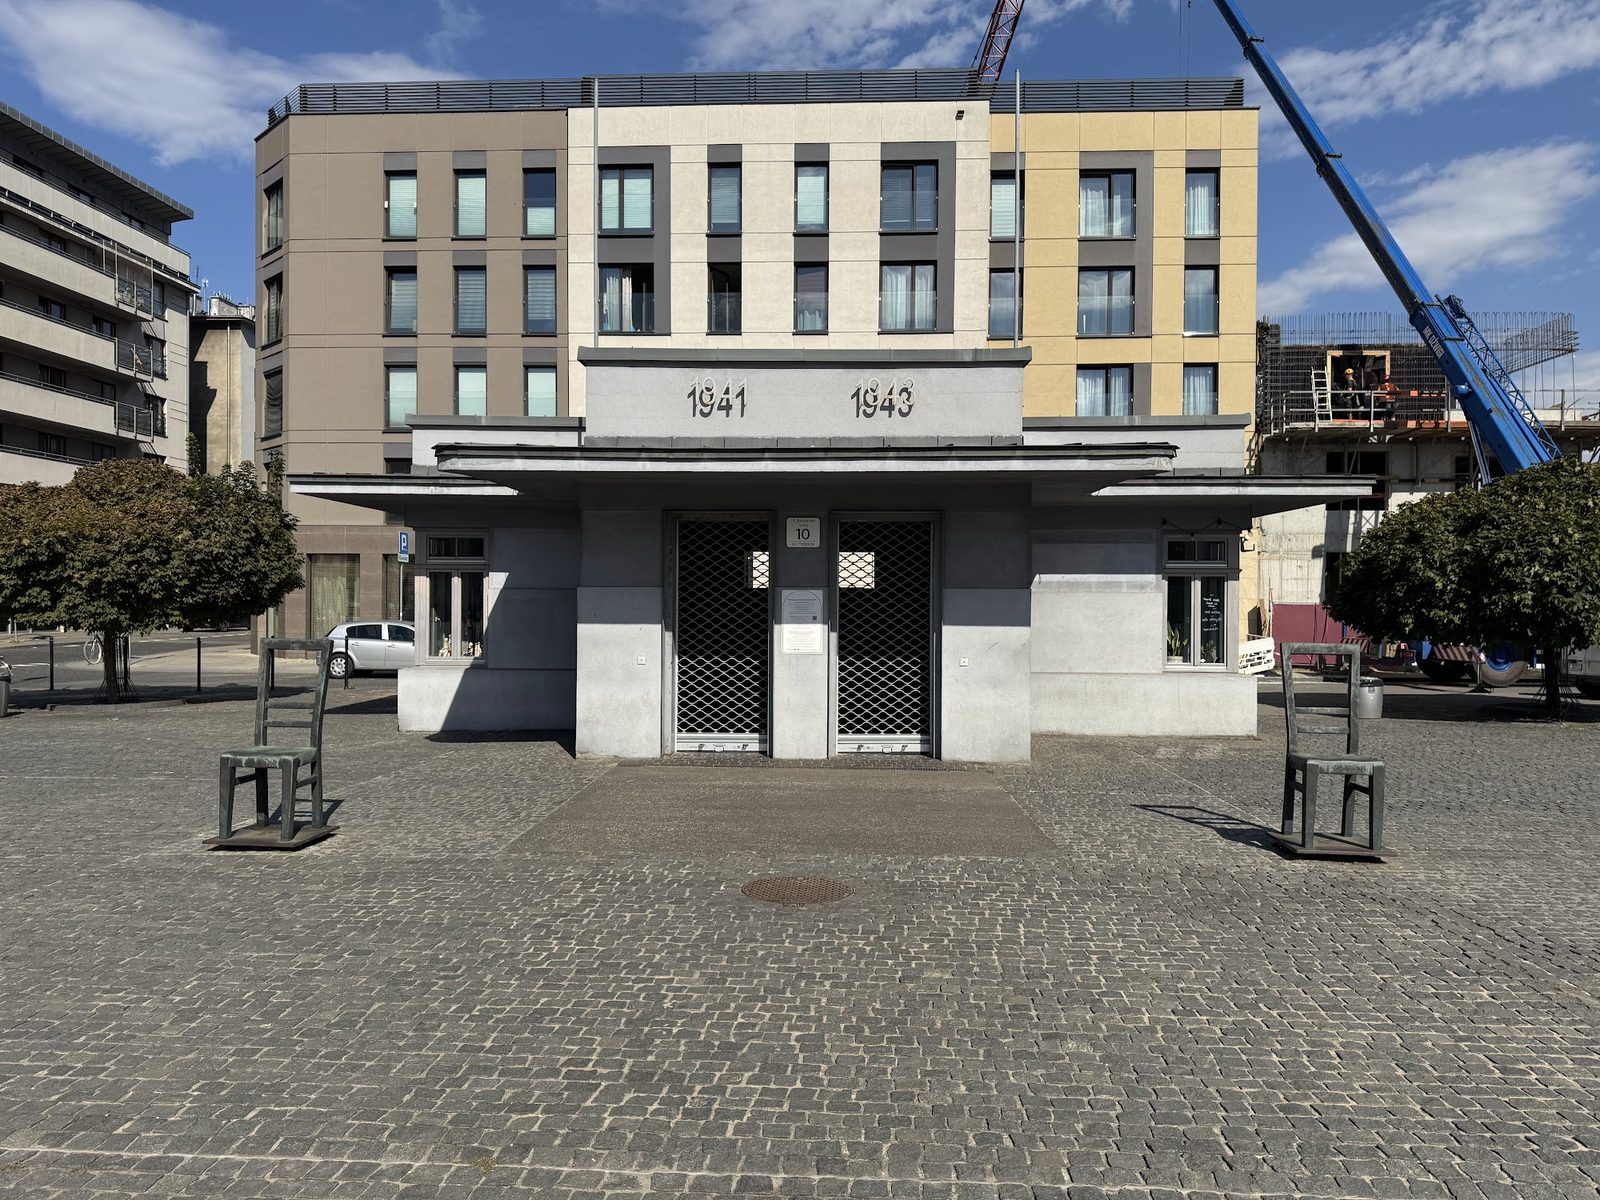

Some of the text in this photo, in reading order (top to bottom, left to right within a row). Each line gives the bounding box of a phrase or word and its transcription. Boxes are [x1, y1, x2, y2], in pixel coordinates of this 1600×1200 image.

[687, 376, 748, 418] 1941
[851, 377, 916, 418] 1943
[401, 534, 407, 551] P
[796, 528, 810, 540] 10
